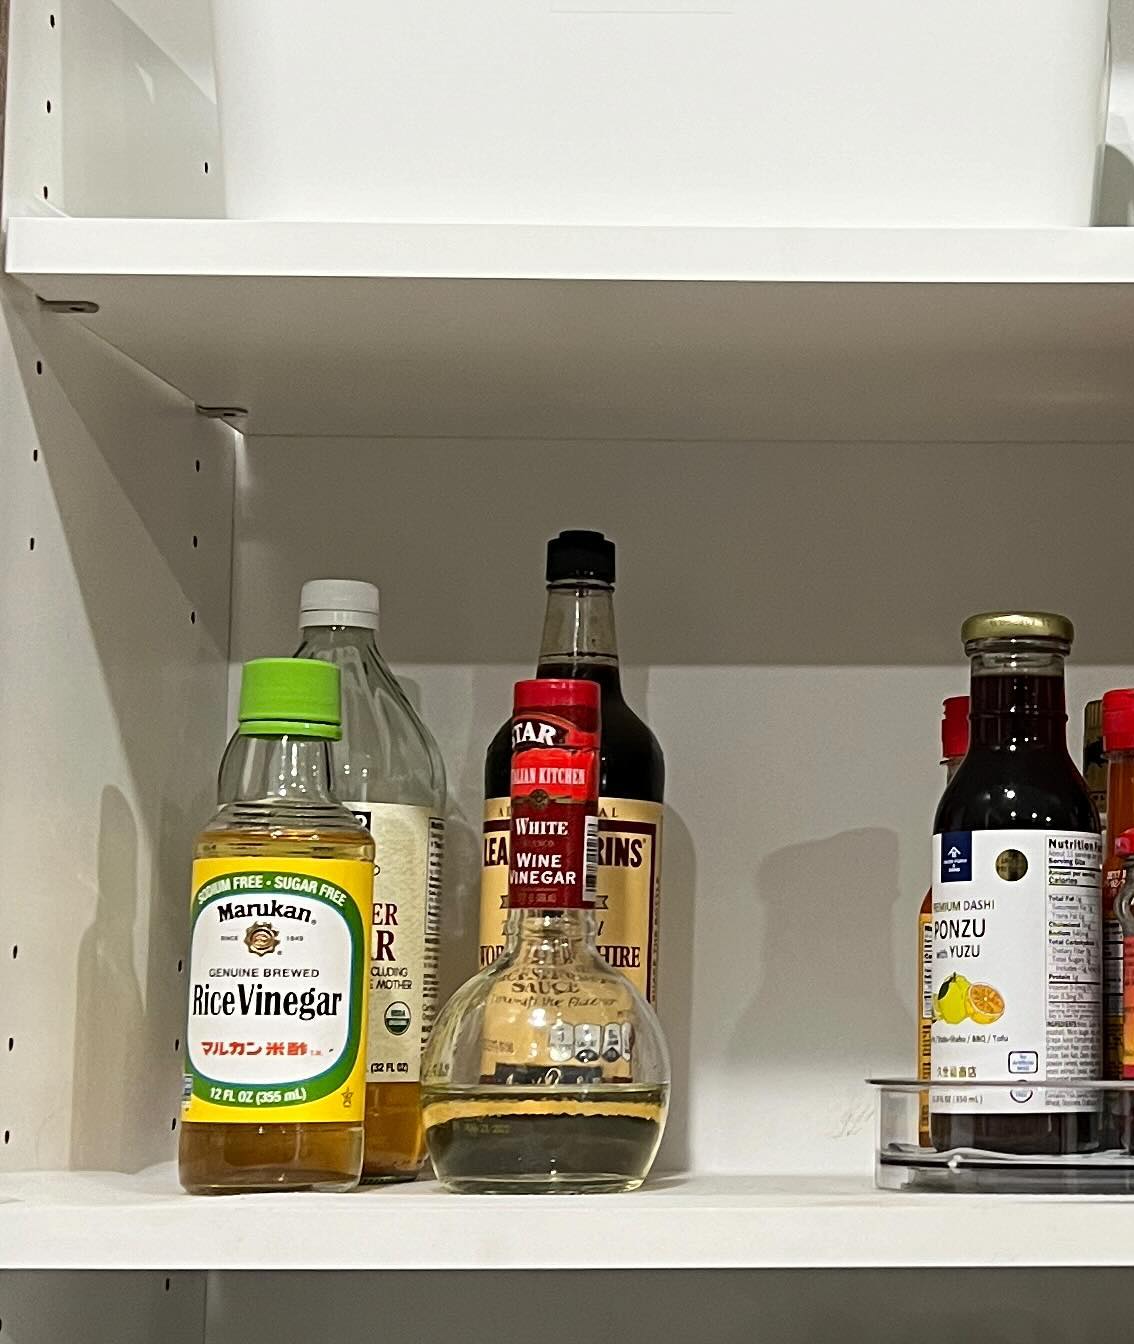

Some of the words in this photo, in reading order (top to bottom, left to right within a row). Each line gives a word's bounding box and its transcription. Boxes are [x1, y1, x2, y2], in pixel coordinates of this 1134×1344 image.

[538, 768, 585, 785] KITCHEN
[515, 817, 569, 835] WHITE
[516, 852, 562, 868] WINE
[598, 837, 643, 868] RINS
[232, 875, 264, 890] FREE
[273, 875, 318, 894] SUGAR
[318, 884, 348, 907] FREE
[217, 900, 312, 923] Marukan
[934, 900, 961, 913] EMIUM
[963, 899, 995, 911] DASHI
[934, 918, 986, 940] PONZU
[949, 945, 981, 958] YUZU
[208, 968, 259, 978] GENUINE
[263, 968, 320, 978] BREWED
[371, 966, 409, 977] CLUDING
[375, 979, 413, 990] MOTHER
[193, 984, 236, 1016] Rice
[237, 983, 343, 1021] Vinegar
[210, 1087, 222, 1100] 12
[222, 1089, 236, 1102] FL
[237, 1090, 253, 1103] OZ
[255, 1091, 282, 1106] (355
